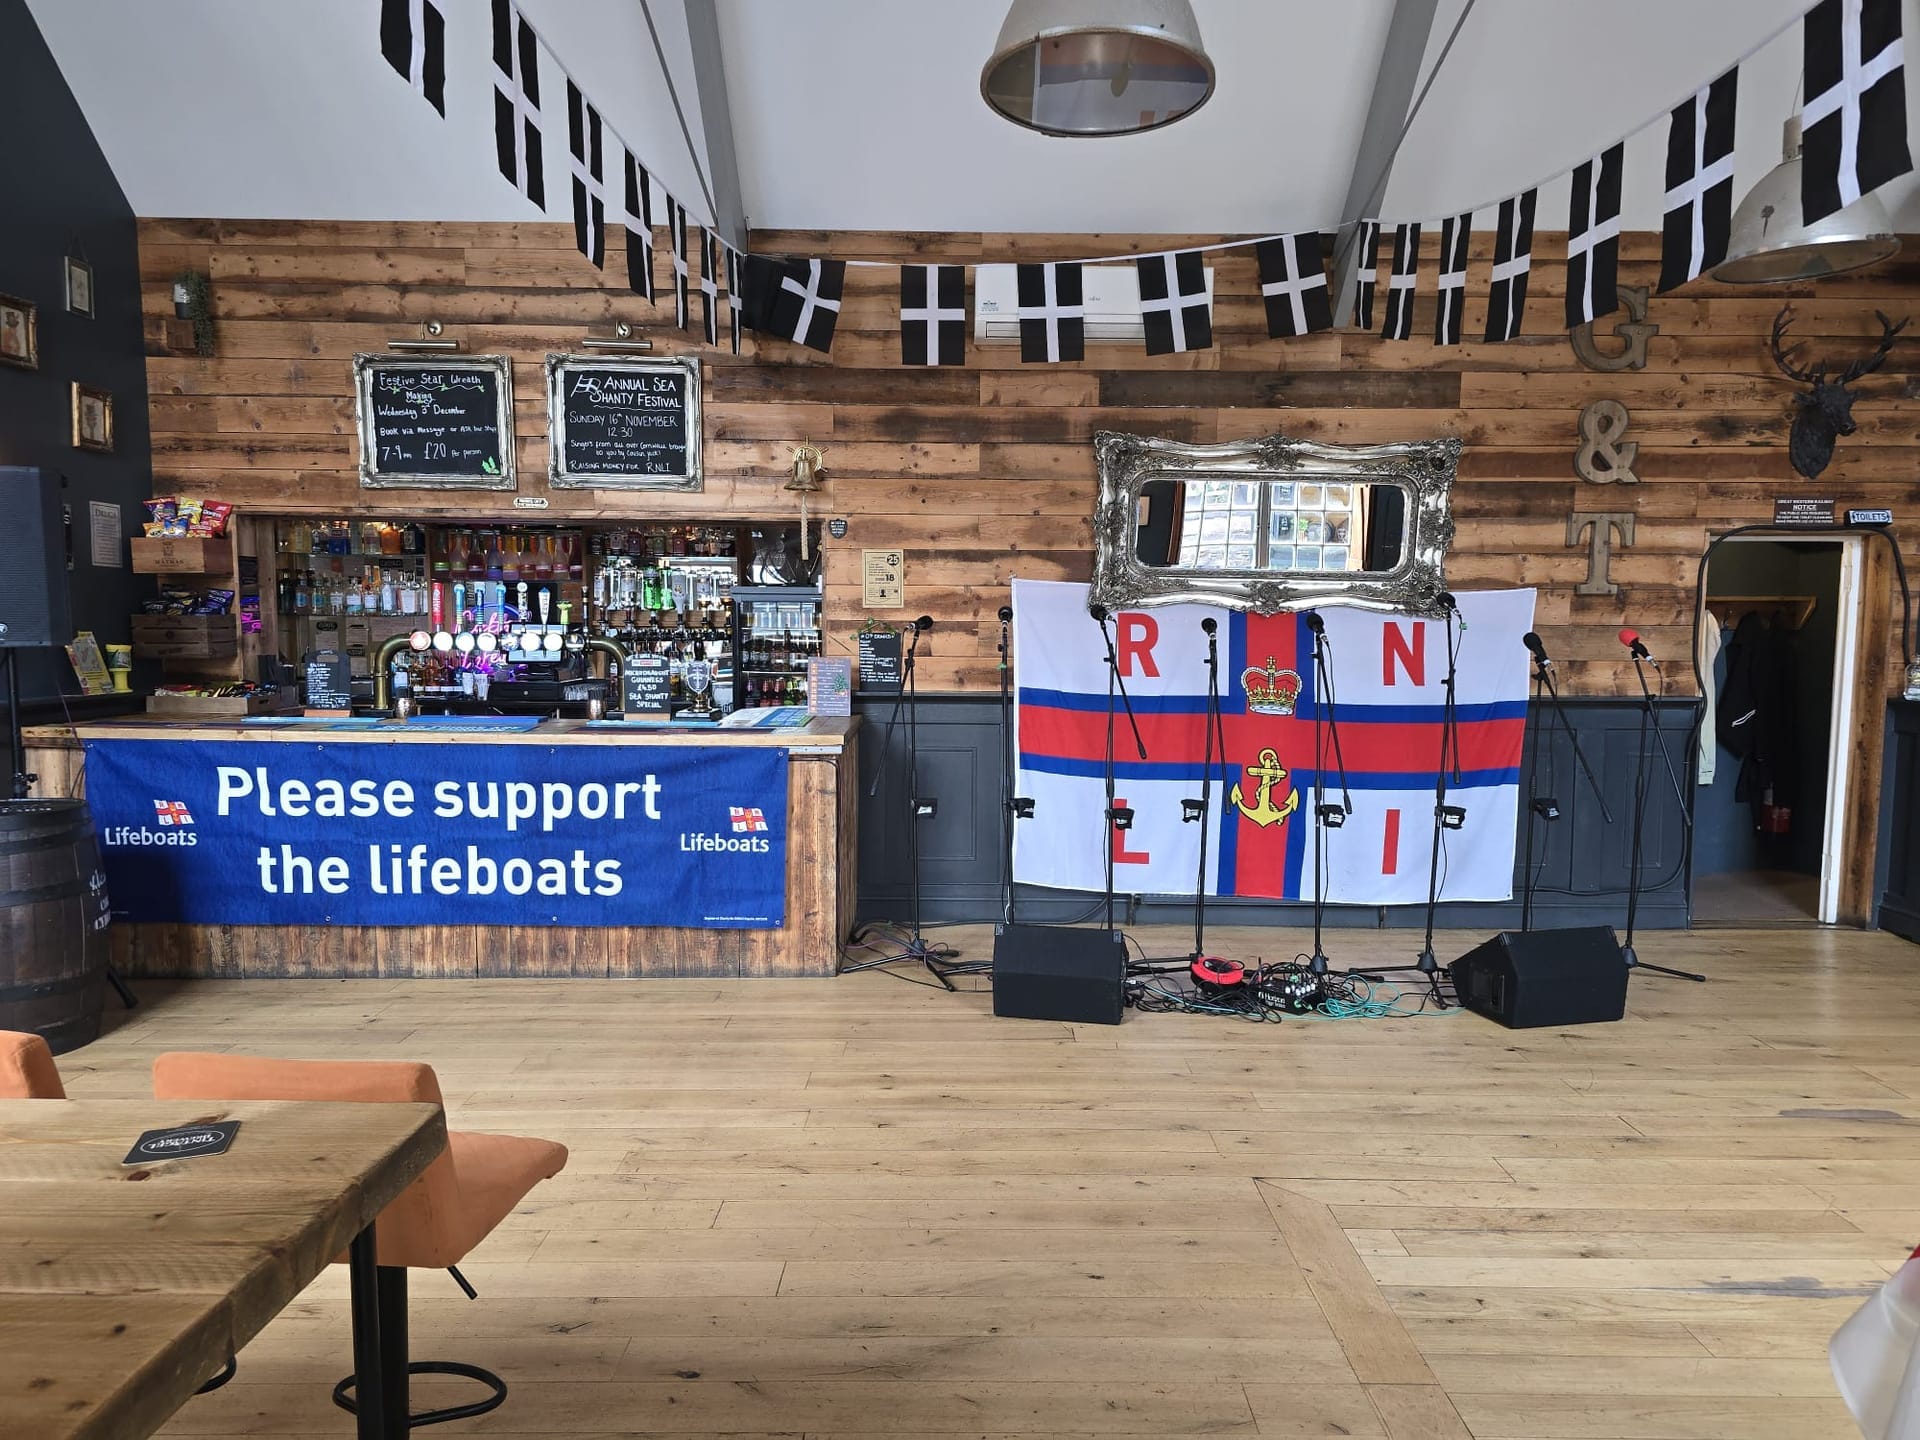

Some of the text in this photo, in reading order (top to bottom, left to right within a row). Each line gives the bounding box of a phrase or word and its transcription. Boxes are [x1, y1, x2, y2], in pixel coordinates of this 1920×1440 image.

[380, 373, 481, 386] Festive Star Wreath
[604, 376, 676, 392] ANNUAL SEA
[406, 391, 433, 403] Making
[590, 390, 682, 408] SHANTY FESTIVAL
[378, 404, 417, 420] Wednesday
[433, 404, 466, 415] December
[569, 411, 605, 426] SUNDAY
[625, 415, 678, 427] NOVEMBER
[596, 441, 611, 449] from
[1566, 285, 1659, 595] G & T
[424, 442, 446, 459] £20
[569, 460, 599, 470] RAISING
[602, 462, 625, 471] MONEY
[646, 462, 670, 472] RNLI
[1856, 513, 1886, 521] TOILETS
[1117, 613, 1425, 686] R N
[216, 766, 661, 831] Please support
[104, 826, 198, 846] Lifeboats
[680, 833, 770, 852] Lifeboats
[1382, 809, 1400, 874] I
[257, 844, 623, 896] the lifeboats
